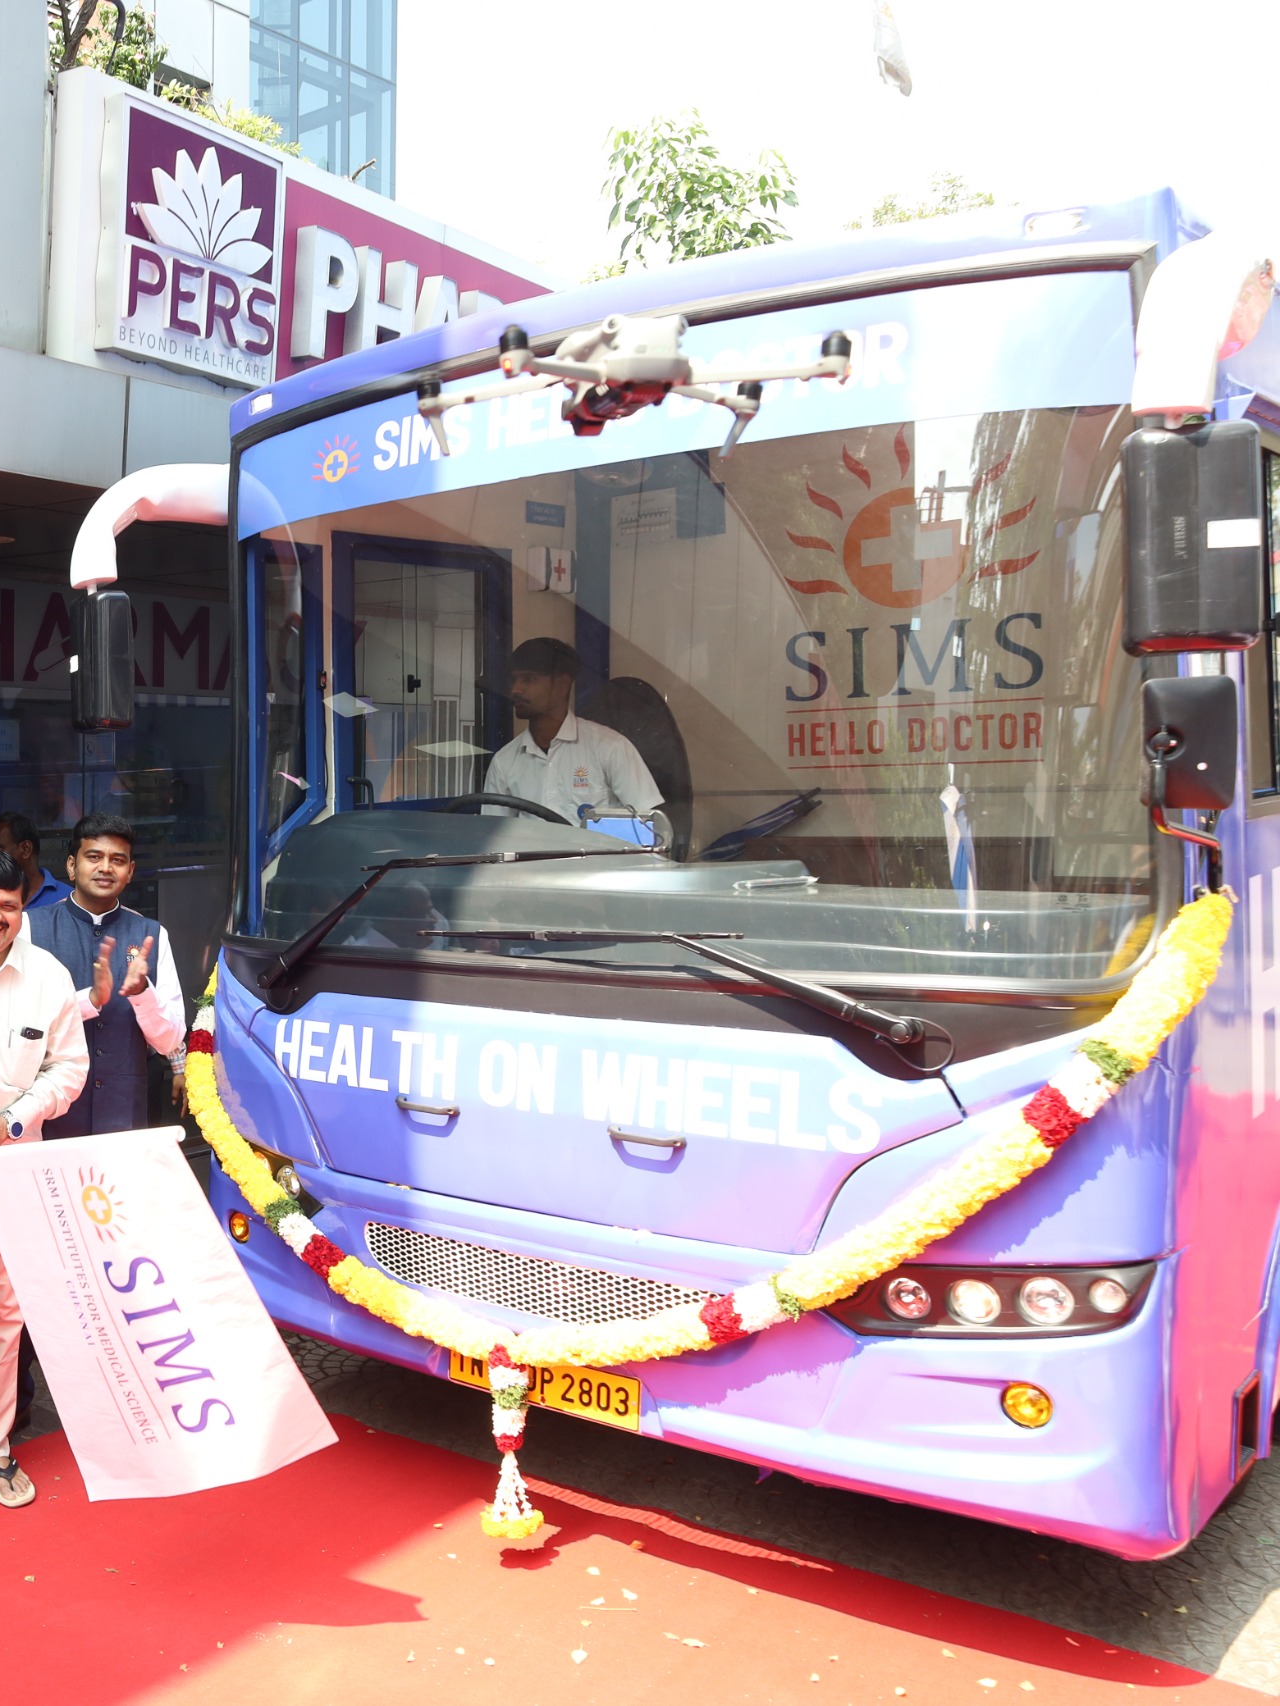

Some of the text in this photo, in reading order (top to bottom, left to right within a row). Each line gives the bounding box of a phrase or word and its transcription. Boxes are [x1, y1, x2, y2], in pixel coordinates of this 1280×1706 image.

[122, 243, 277, 357] PERS
[291, 224, 506, 361] PHA
[119, 325, 267, 381] BEYOND HEALTHCARE
[373, 408, 473, 472] SIMS
[784, 611, 1045, 702] SIMS
[787, 711, 1044, 757] HELLO DOCTOR
[274, 1018, 884, 1155] HEALTH ON WHEELS
[42, 1167, 158, 1445] SRM INSTITUTES FOR MEDICAL SCIENCE
[65, 1279, 95, 1348] CHENNAI
[102, 1256, 236, 1434] SIMS
[560, 1372, 631, 1416] 2803
